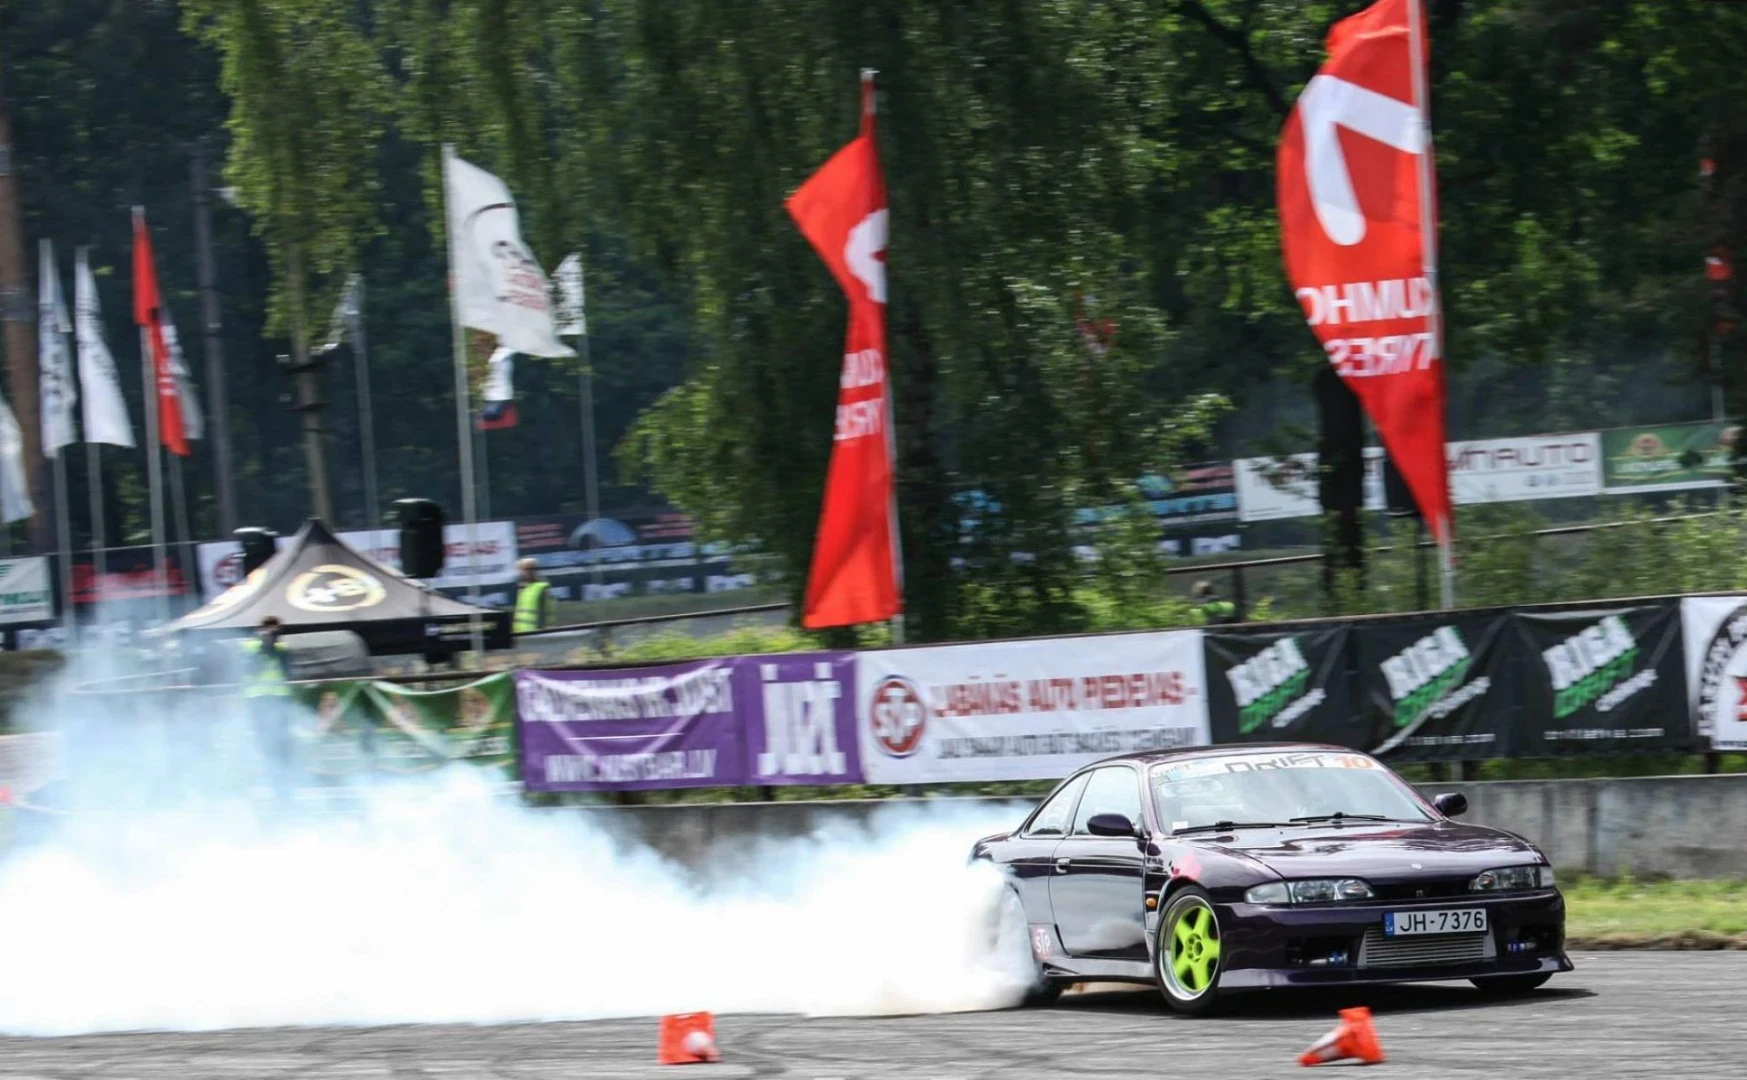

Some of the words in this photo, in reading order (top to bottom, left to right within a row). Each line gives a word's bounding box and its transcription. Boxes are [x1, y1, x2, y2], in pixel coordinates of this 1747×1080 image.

[875, 687, 921, 745] STP
[1225, 753, 1325, 773] DRIFT
[1334, 755, 1374, 770] 10
[1400, 911, 1484, 932] JH-7376
[1035, 928, 1051, 953] STP
